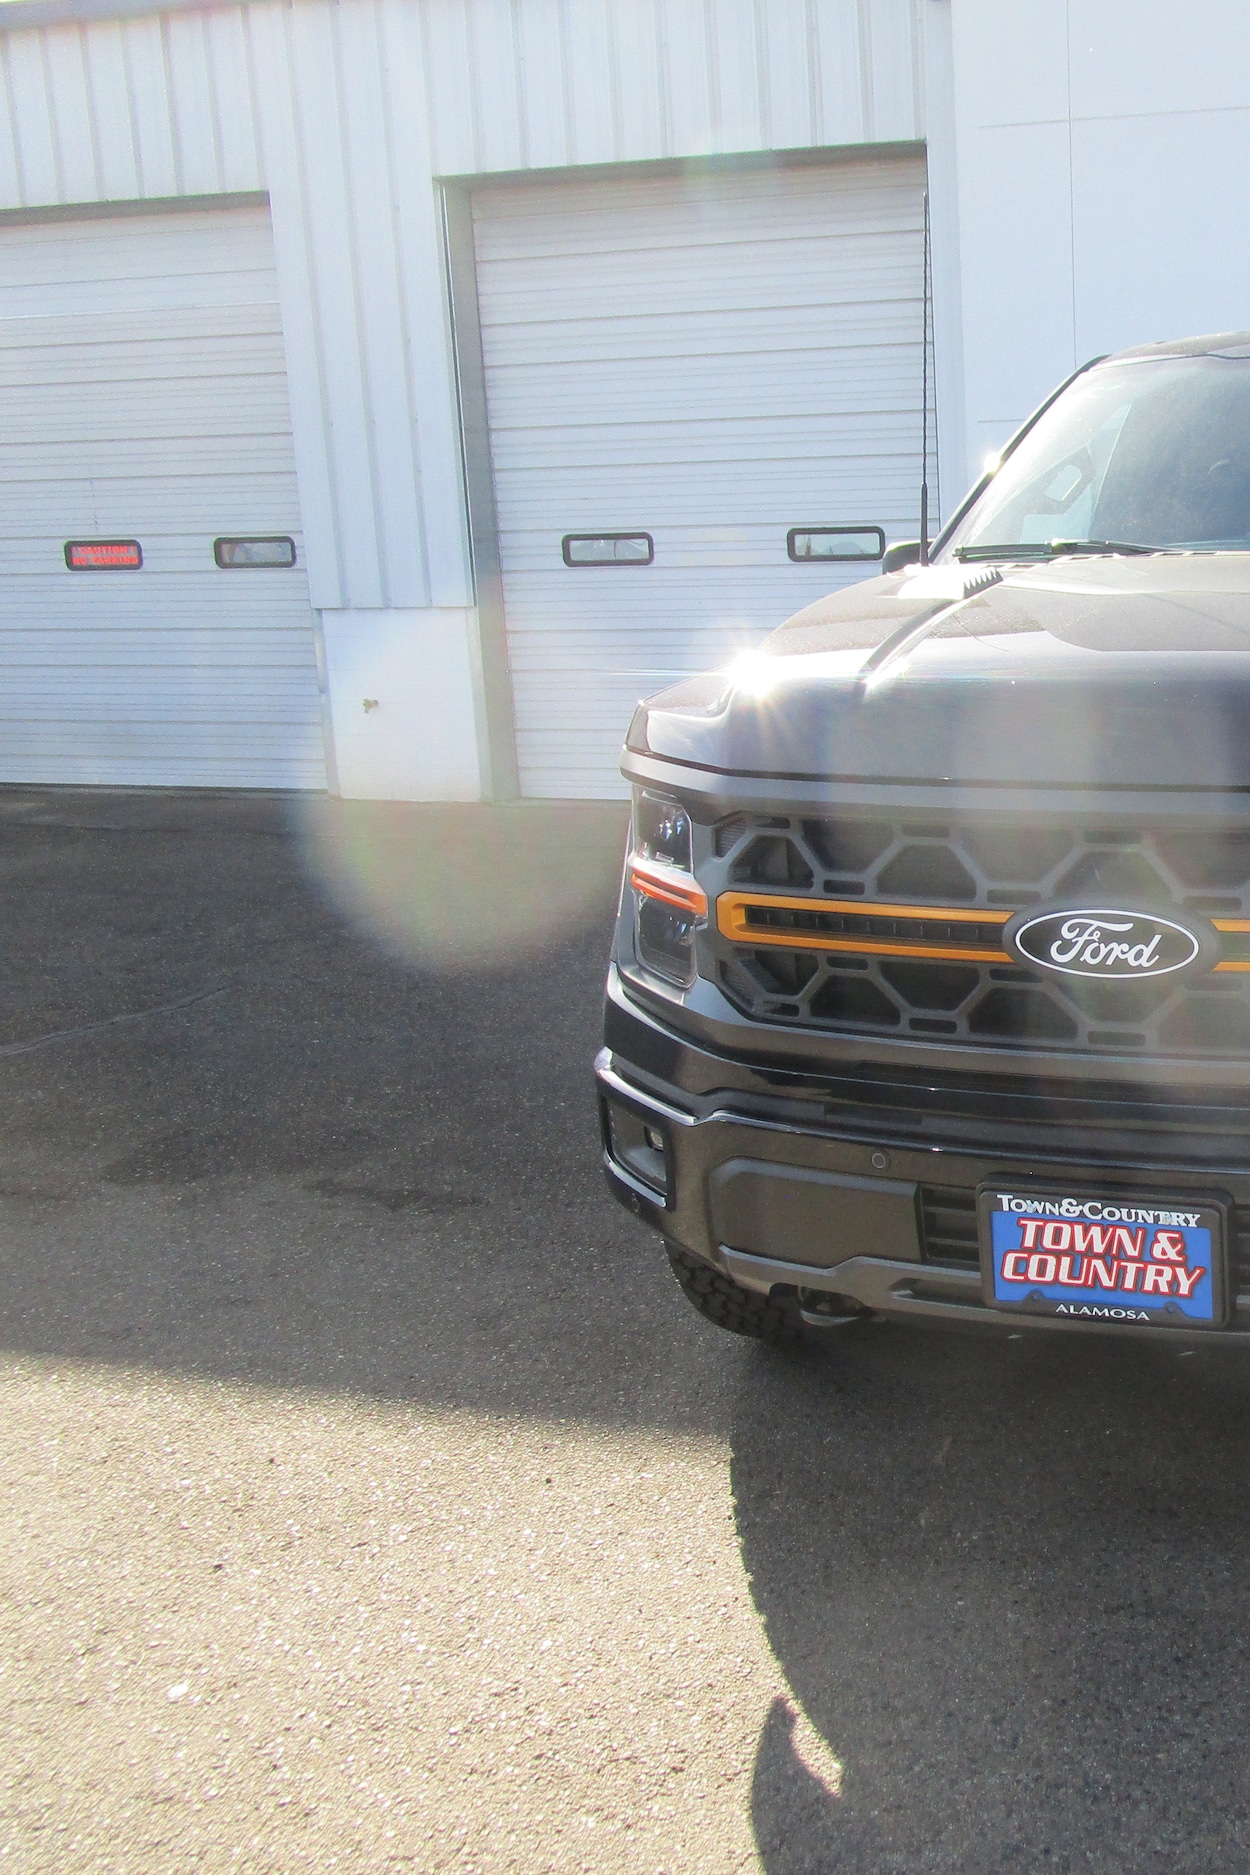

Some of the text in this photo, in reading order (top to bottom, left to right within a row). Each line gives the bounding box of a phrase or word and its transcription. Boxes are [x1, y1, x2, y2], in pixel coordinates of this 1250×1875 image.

[72, 556, 139, 565] NO PARKING
[79, 545, 128, 554] CAUTION
[1050, 918, 1162, 967] Ford
[1017, 1217, 1187, 1263] TOWN &
[1001, 1250, 1206, 1298] COUNTRY
[1055, 1303, 1150, 1321] ALAMOSA
